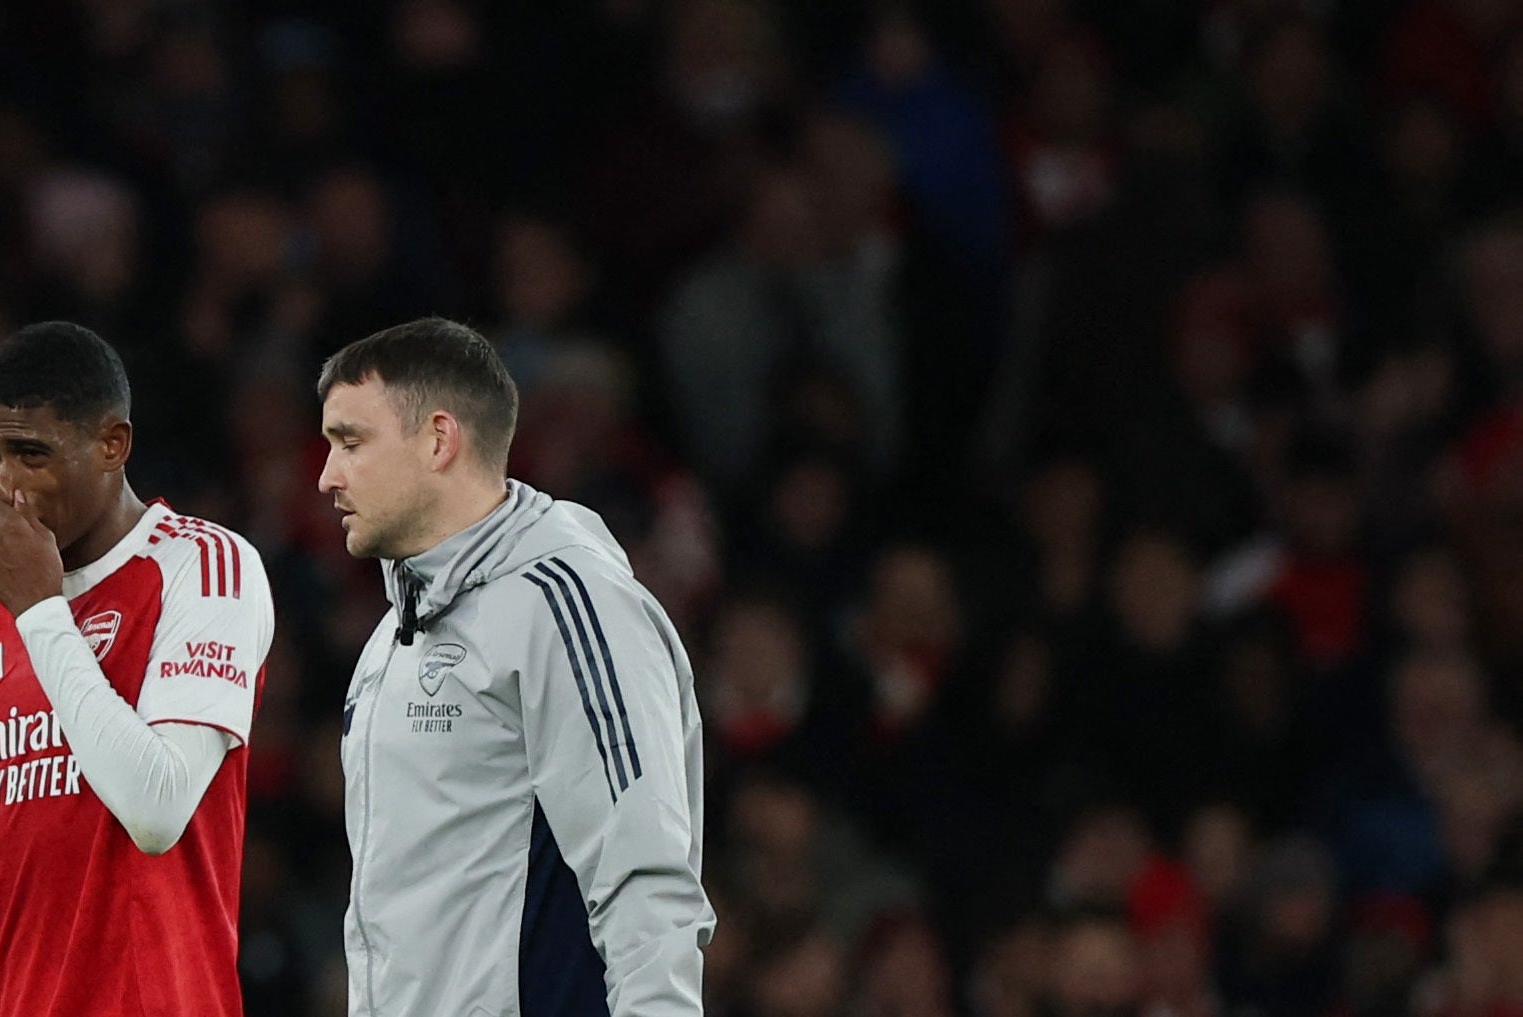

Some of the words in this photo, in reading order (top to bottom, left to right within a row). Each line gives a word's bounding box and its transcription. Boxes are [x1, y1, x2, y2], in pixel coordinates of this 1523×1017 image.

[186, 641, 236, 661] VISIT
[160, 659, 247, 689] RWANDA
[406, 702, 462, 717] Emirates
[412, 720, 424, 732] FLY
[425, 720, 452, 732] BETTER
[5, 754, 81, 805] BETTER
